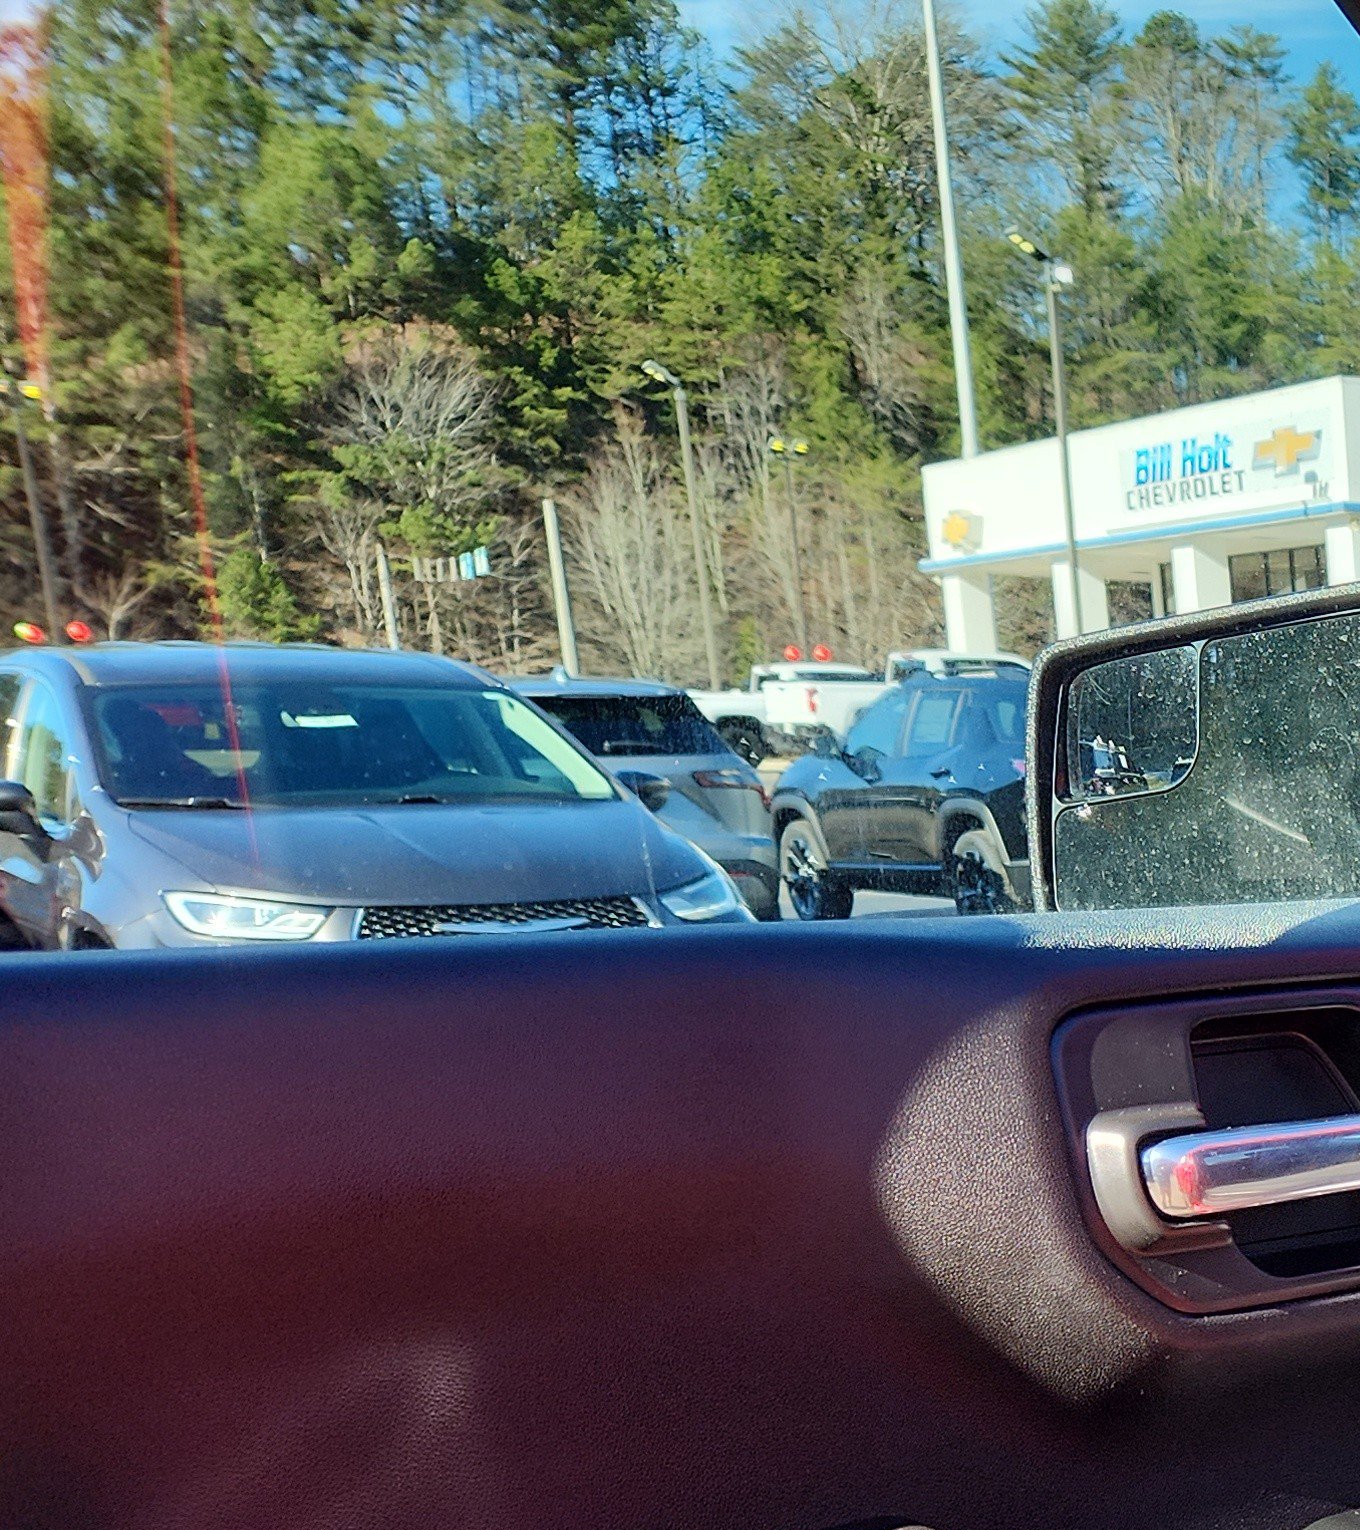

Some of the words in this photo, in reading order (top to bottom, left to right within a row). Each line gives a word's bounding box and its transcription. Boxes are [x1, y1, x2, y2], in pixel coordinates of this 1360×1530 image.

[1136, 444, 1172, 485] Bill
[1181, 431, 1232, 477] Holt
[1126, 470, 1246, 510] CHEVROLET
